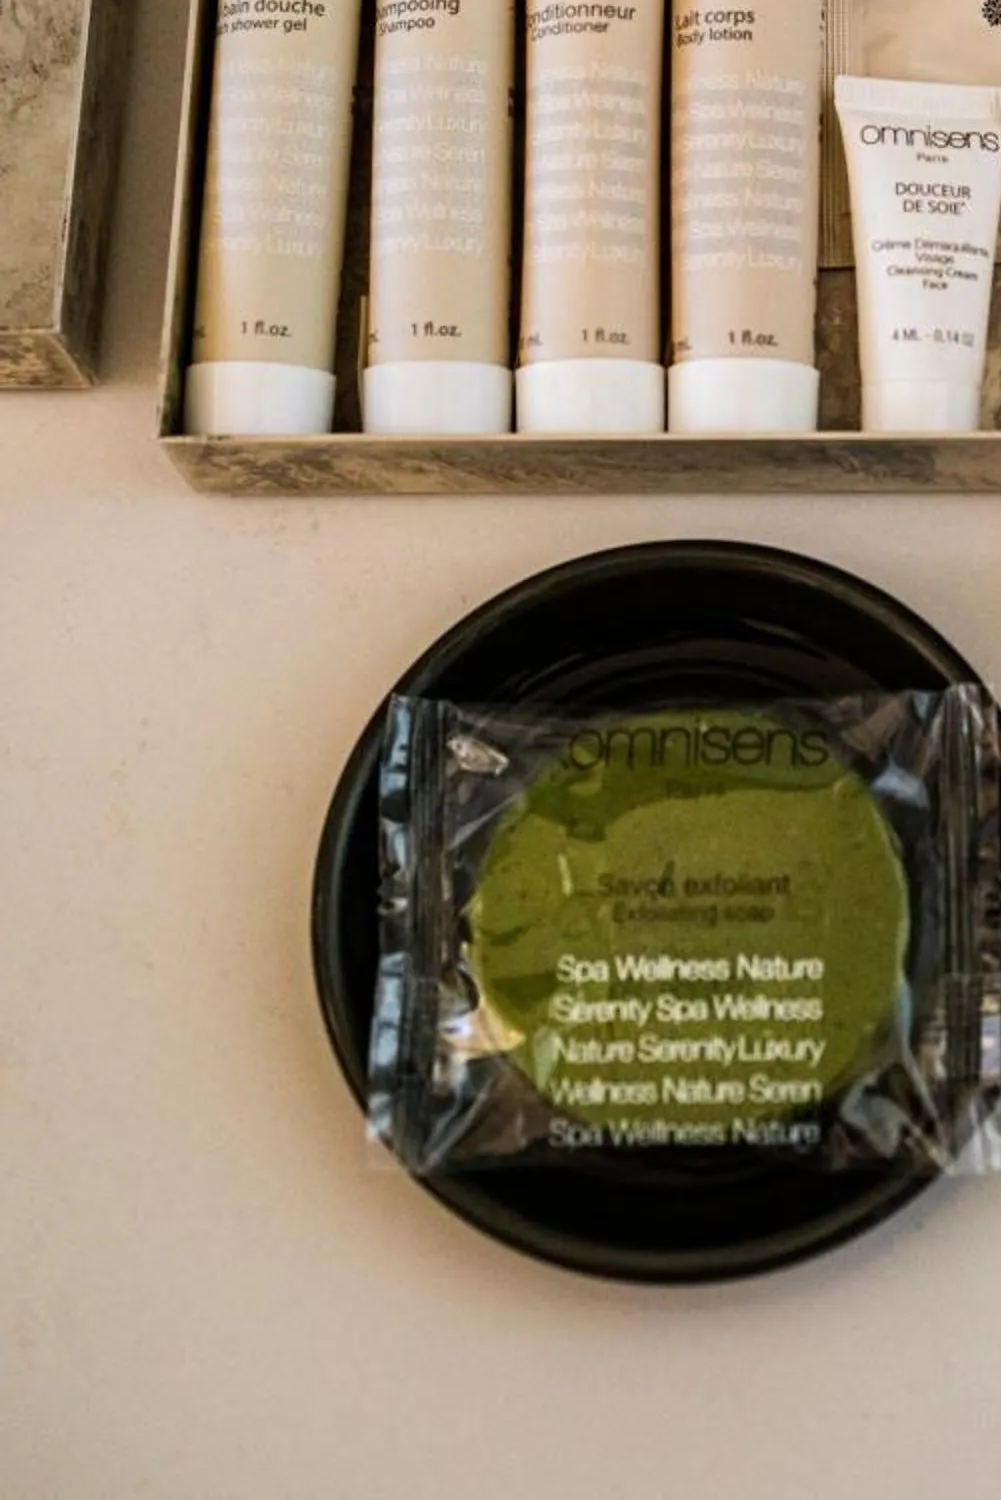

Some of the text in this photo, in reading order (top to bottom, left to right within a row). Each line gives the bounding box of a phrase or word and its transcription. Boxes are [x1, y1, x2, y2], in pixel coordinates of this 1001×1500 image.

[527, 2, 637, 28] onditionneur
[704, 9, 756, 27] corps
[283, 17, 307, 34] gel
[709, 27, 753, 41] lotion
[860, 124, 1000, 152] omnisens
[916, 152, 949, 164] Paris
[895, 181, 971, 199] DOUCEUR
[903, 200, 924, 213] DE
[915, 253, 956, 264] Visage
[922, 280, 950, 291] Face
[241, 321, 248, 334] 1
[411, 323, 418, 336] 1
[581, 329, 588, 342] 1
[729, 331, 735, 344] 1
[569, 725, 830, 770] omnisens
[557, 953, 824, 985] Spa Wellness Nature
[553, 994, 823, 1026] Serenity Spa Wellness
[553, 1033, 826, 1067] Nature Serenity Luxury
[553, 1073, 823, 1105] Wellness Nature Seren
[550, 1118, 821, 1149] Spa Wellness Nature
